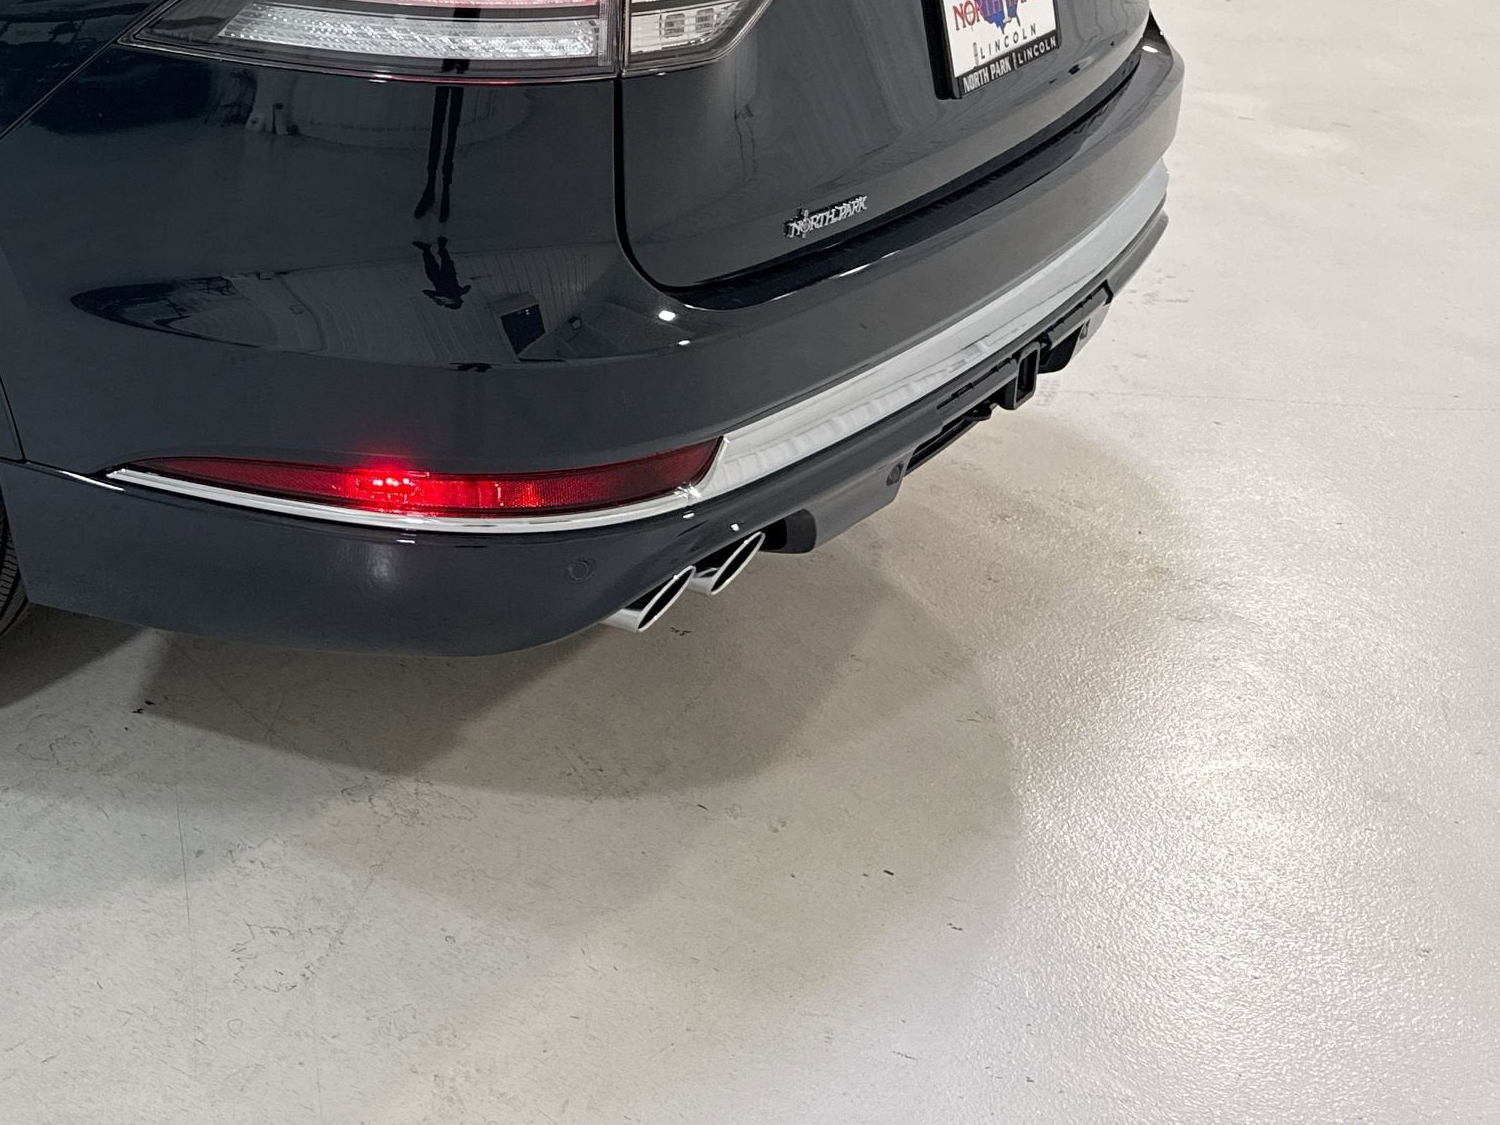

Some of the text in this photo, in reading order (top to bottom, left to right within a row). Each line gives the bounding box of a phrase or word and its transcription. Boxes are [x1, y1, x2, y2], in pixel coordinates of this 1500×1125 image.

[963, 35, 1057, 93] NORTH PARK LINCOLN
[980, 23, 1037, 59] LINCOLN
